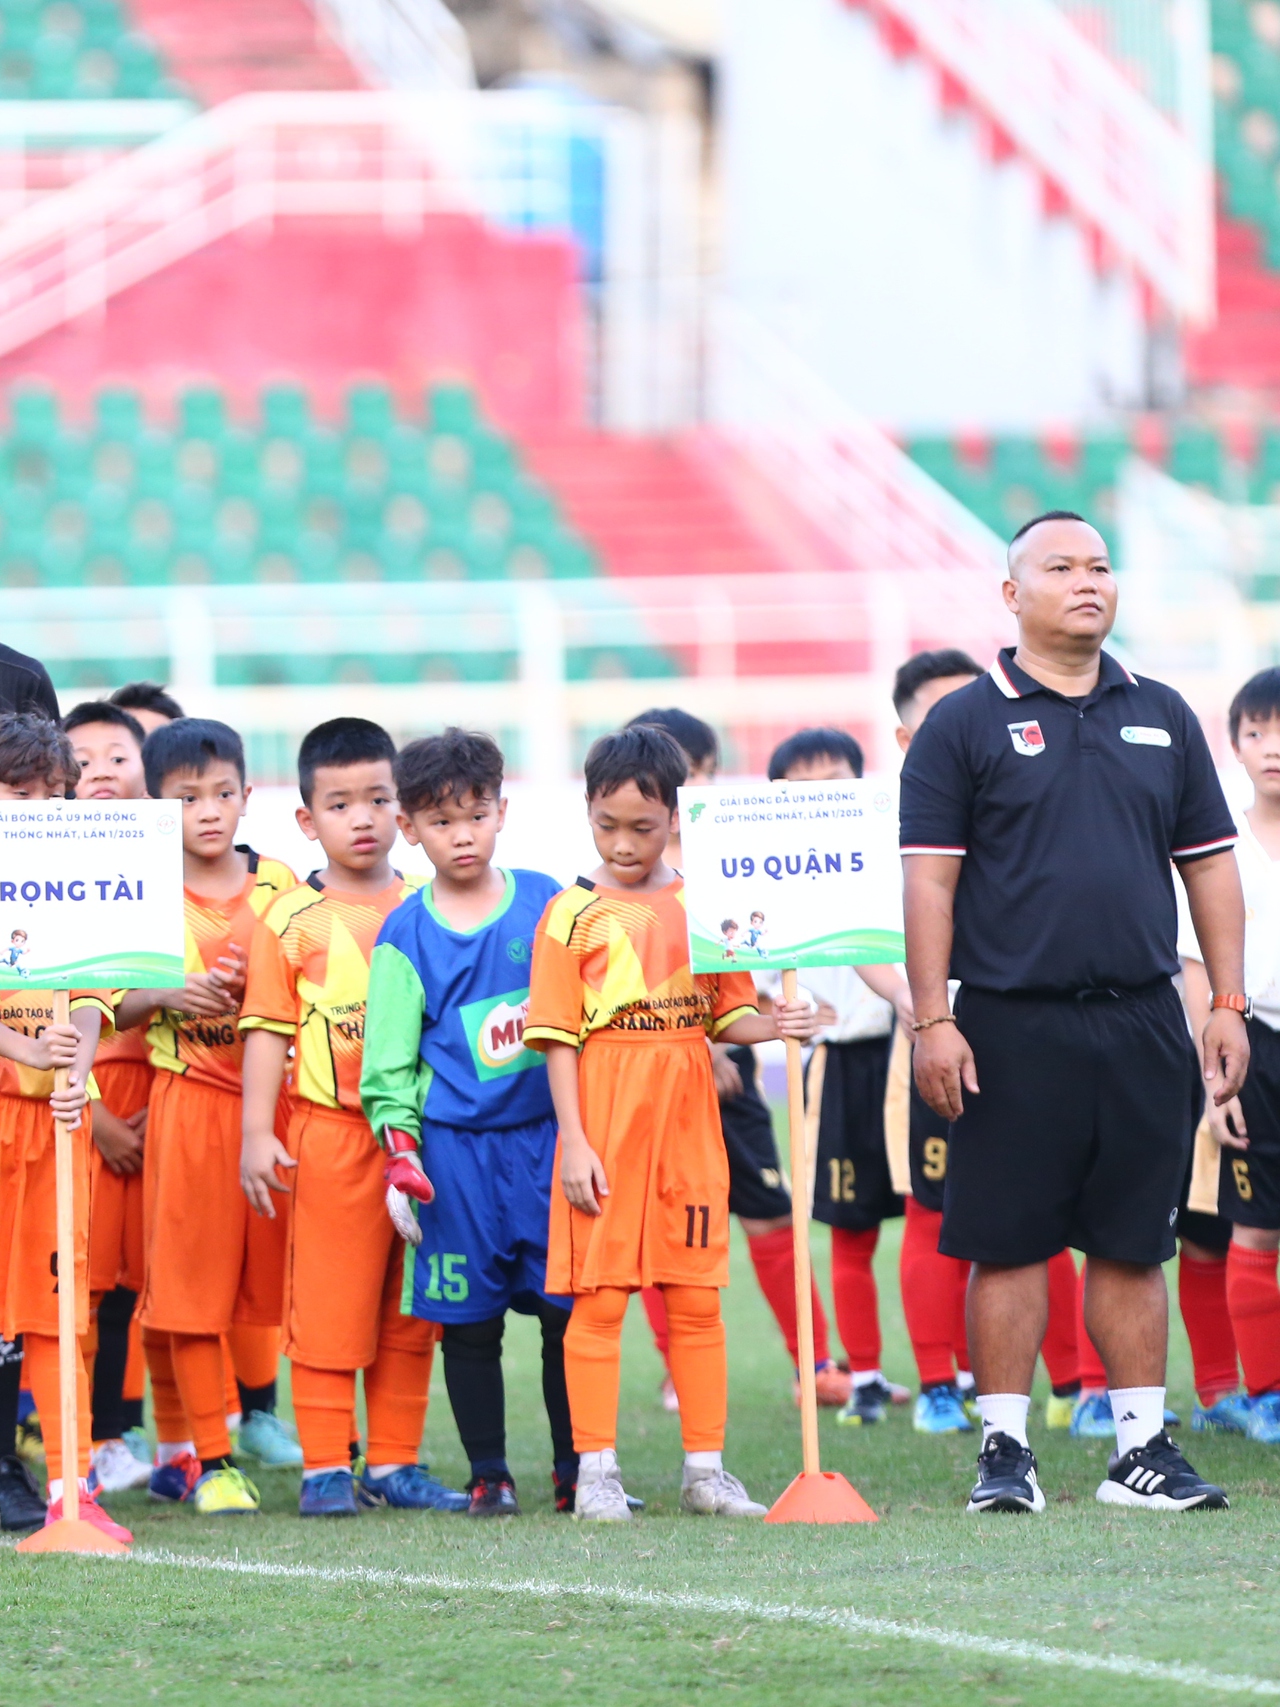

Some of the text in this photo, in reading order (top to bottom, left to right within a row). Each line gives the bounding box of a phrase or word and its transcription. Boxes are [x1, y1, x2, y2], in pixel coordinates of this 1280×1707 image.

[793, 794, 806, 803] U9
[12, 811, 44, 823] BÓNG
[66, 813, 81, 822] U9
[831, 808, 864, 819] 1/2025
[109, 829, 145, 840] 1/2025
[721, 848, 865, 880] U9 QUẬN 5
[95, 874, 144, 901] TÀI
[3, 1006, 23, 1019] ĐÀO
[330, 1002, 361, 1016] TRUNG
[924, 1136, 947, 1180] 9
[828, 1157, 856, 1202] 12
[1232, 1158, 1253, 1201] 6
[685, 1204, 709, 1249] 11
[425, 1253, 469, 1302] 15
